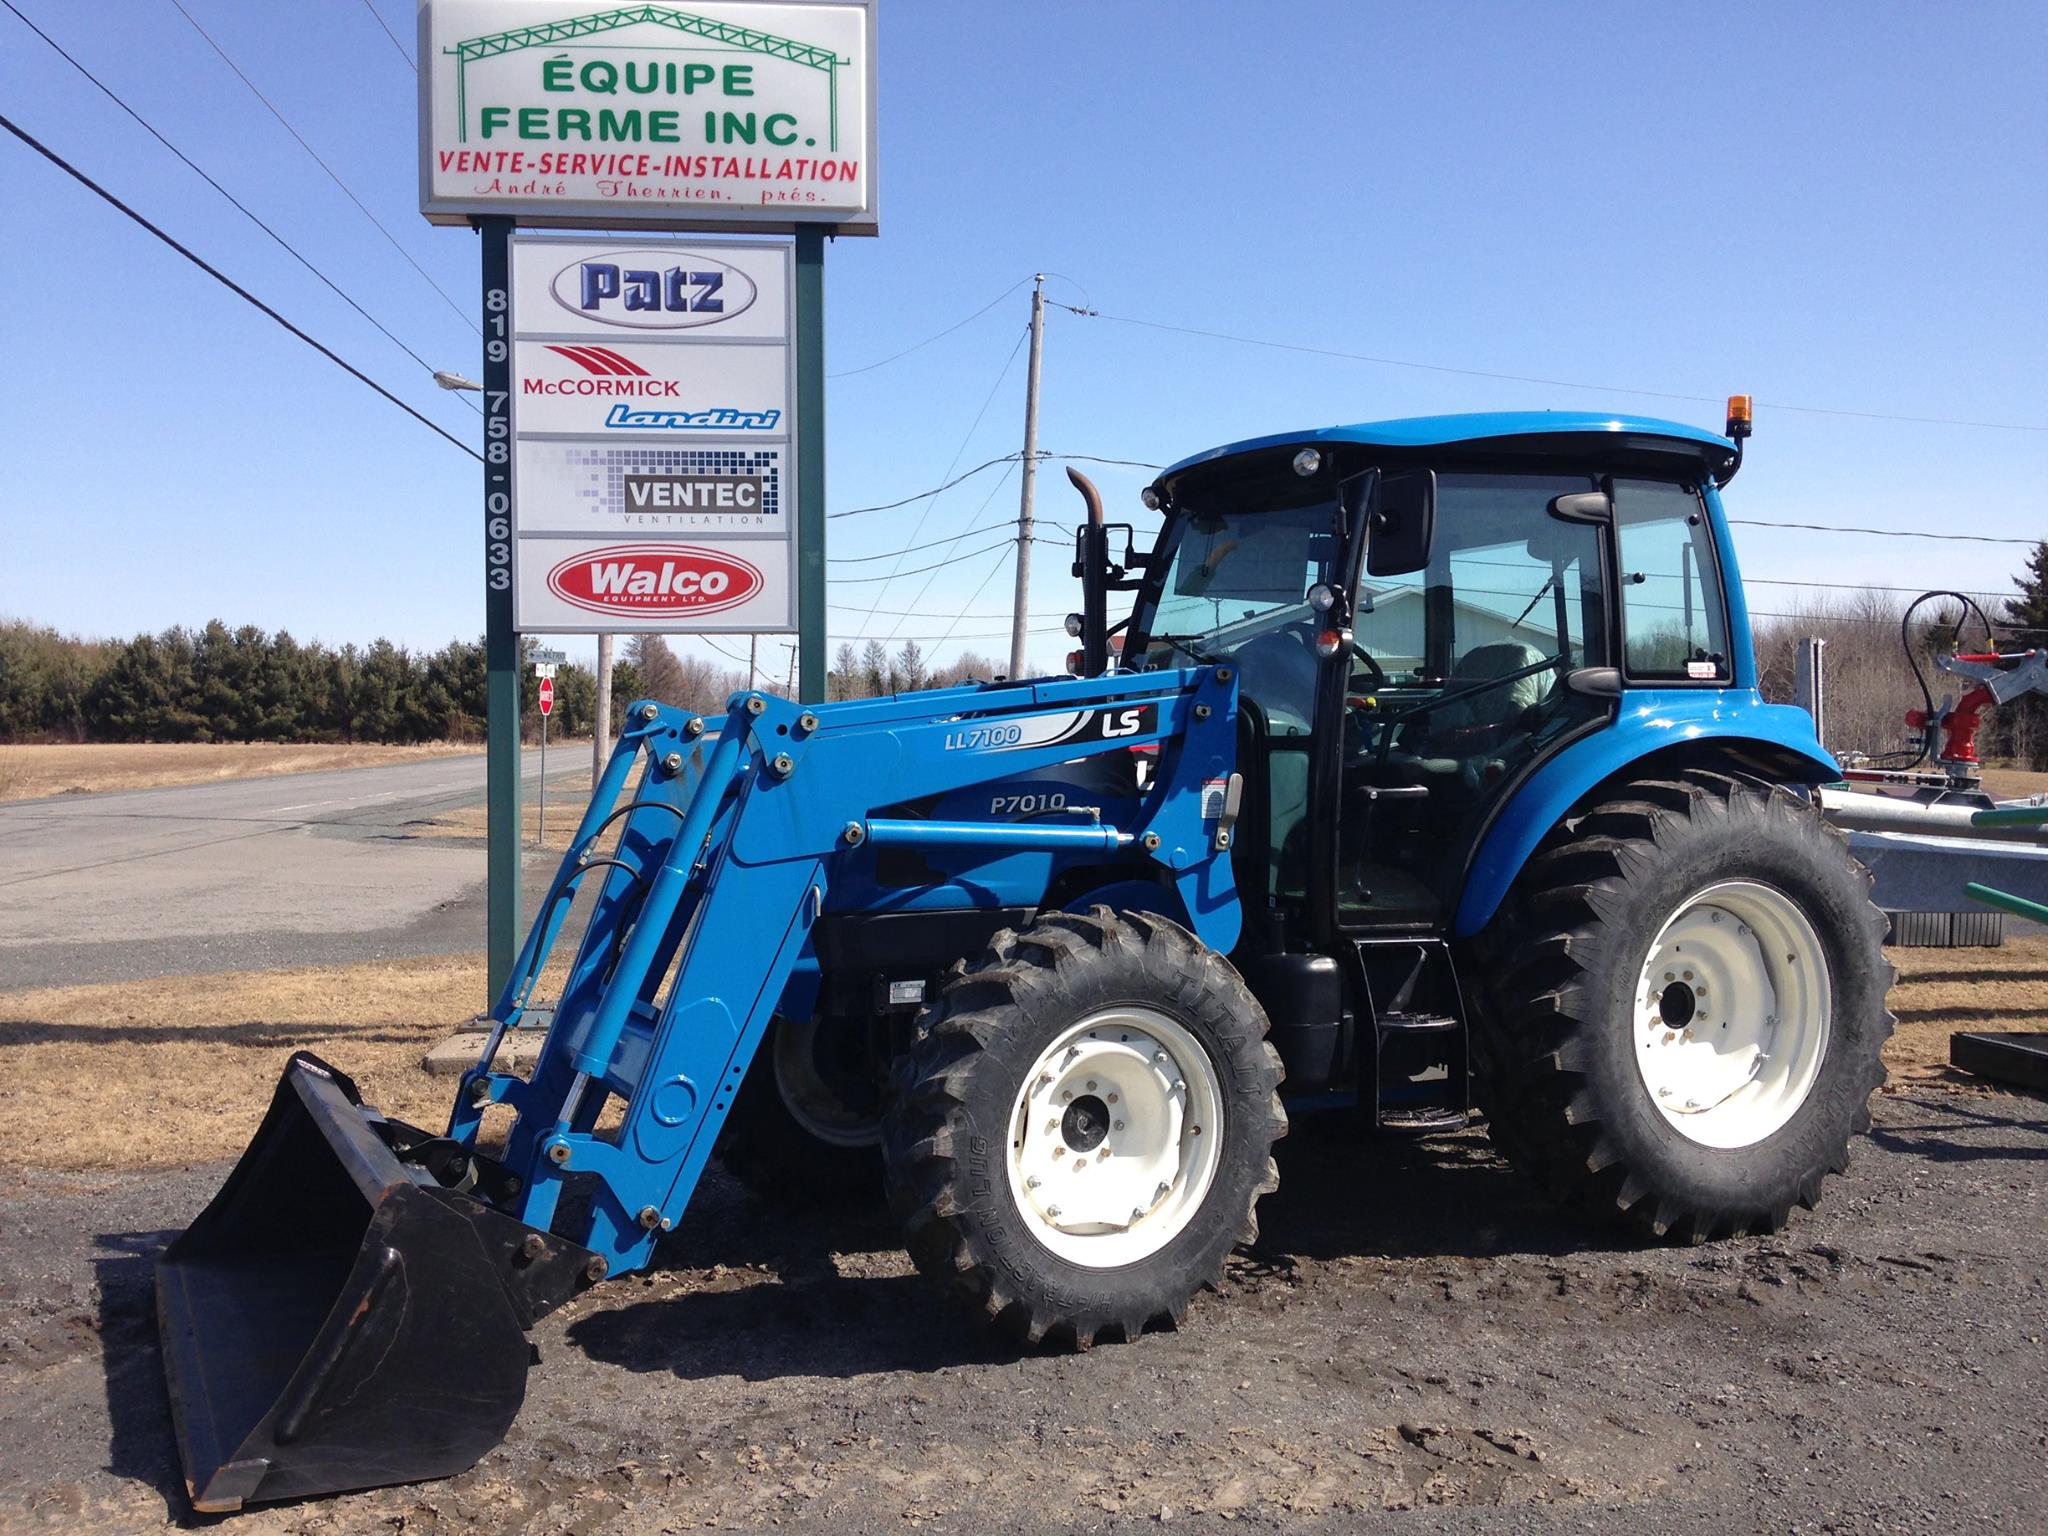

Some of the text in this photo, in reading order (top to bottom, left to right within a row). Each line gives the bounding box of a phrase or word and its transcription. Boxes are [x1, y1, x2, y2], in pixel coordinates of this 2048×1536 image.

[542, 54, 754, 96] ÉQUIPE
[480, 107, 817, 147] FERME INC.
[439, 151, 858, 182] VENTE-SERVICE-INSTALLATION
[474, 178, 567, 196] André
[760, 188, 827, 205] prés.
[581, 263, 723, 313] Patz
[523, 378, 681, 397] McCORMICK
[605, 404, 781, 431] Landini
[486, 288, 511, 591] 819 758-0633
[629, 482, 756, 507] VENTEC
[624, 514, 765, 525] VENTILATION
[590, 562, 729, 595] Walco
[603, 595, 707, 603] EQUIPMENT LTD.
[944, 709, 1141, 751] LL7100 LS
[990, 793, 1066, 815] P7010
[969, 1134, 993, 1197] LUG
